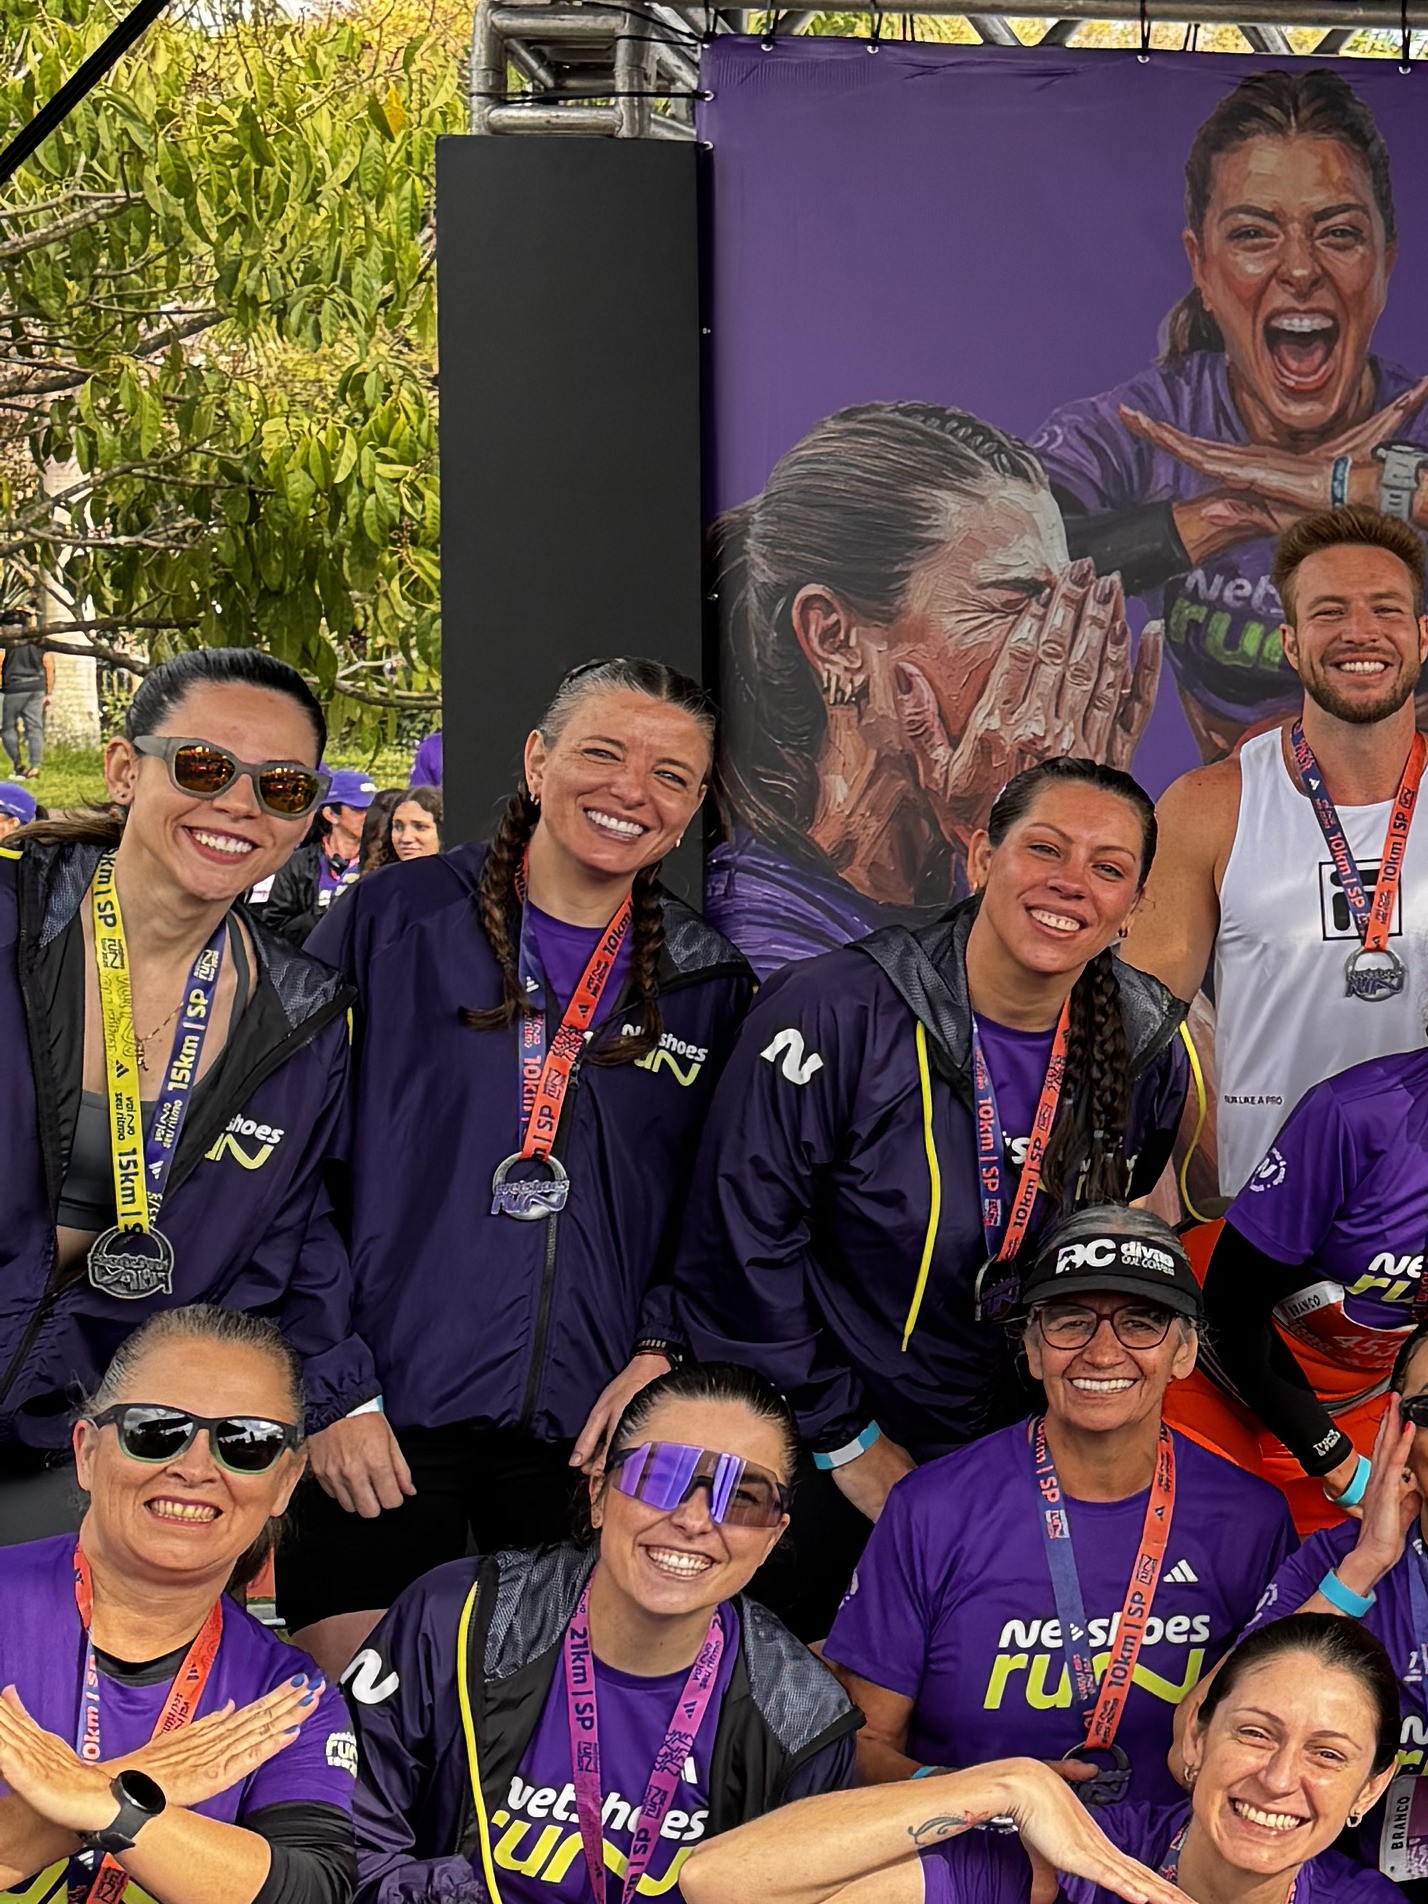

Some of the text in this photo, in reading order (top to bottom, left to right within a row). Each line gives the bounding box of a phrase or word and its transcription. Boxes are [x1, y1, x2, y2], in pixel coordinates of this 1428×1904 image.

[1185, 570, 1284, 615] Nets
[1167, 598, 1285, 671] ru
[1329, 831, 1367, 910] 10km SP
[1380, 811, 1407, 883] 10km SP
[98, 901, 118, 930] SP
[603, 912, 632, 957] 10km
[166, 1032, 201, 1092] 15km
[193, 988, 207, 1019] SP
[622, 1024, 709, 1063] Nshoes
[537, 1106, 554, 1132] SP
[977, 1097, 1000, 1193] 10km SP
[117, 1147, 141, 1208] 15km
[1014, 1136, 1042, 1227] 10km SP
[1039, 1476, 1061, 1503] SP
[1107, 1590, 1144, 1689] 10km SP
[570, 1626, 594, 1731] 21km SP
[82, 1709, 102, 1764] 0km
[490, 1810, 696, 1896] un
[633, 1827, 652, 1855] SP
[1391, 1795, 1411, 1851] BRANCO
